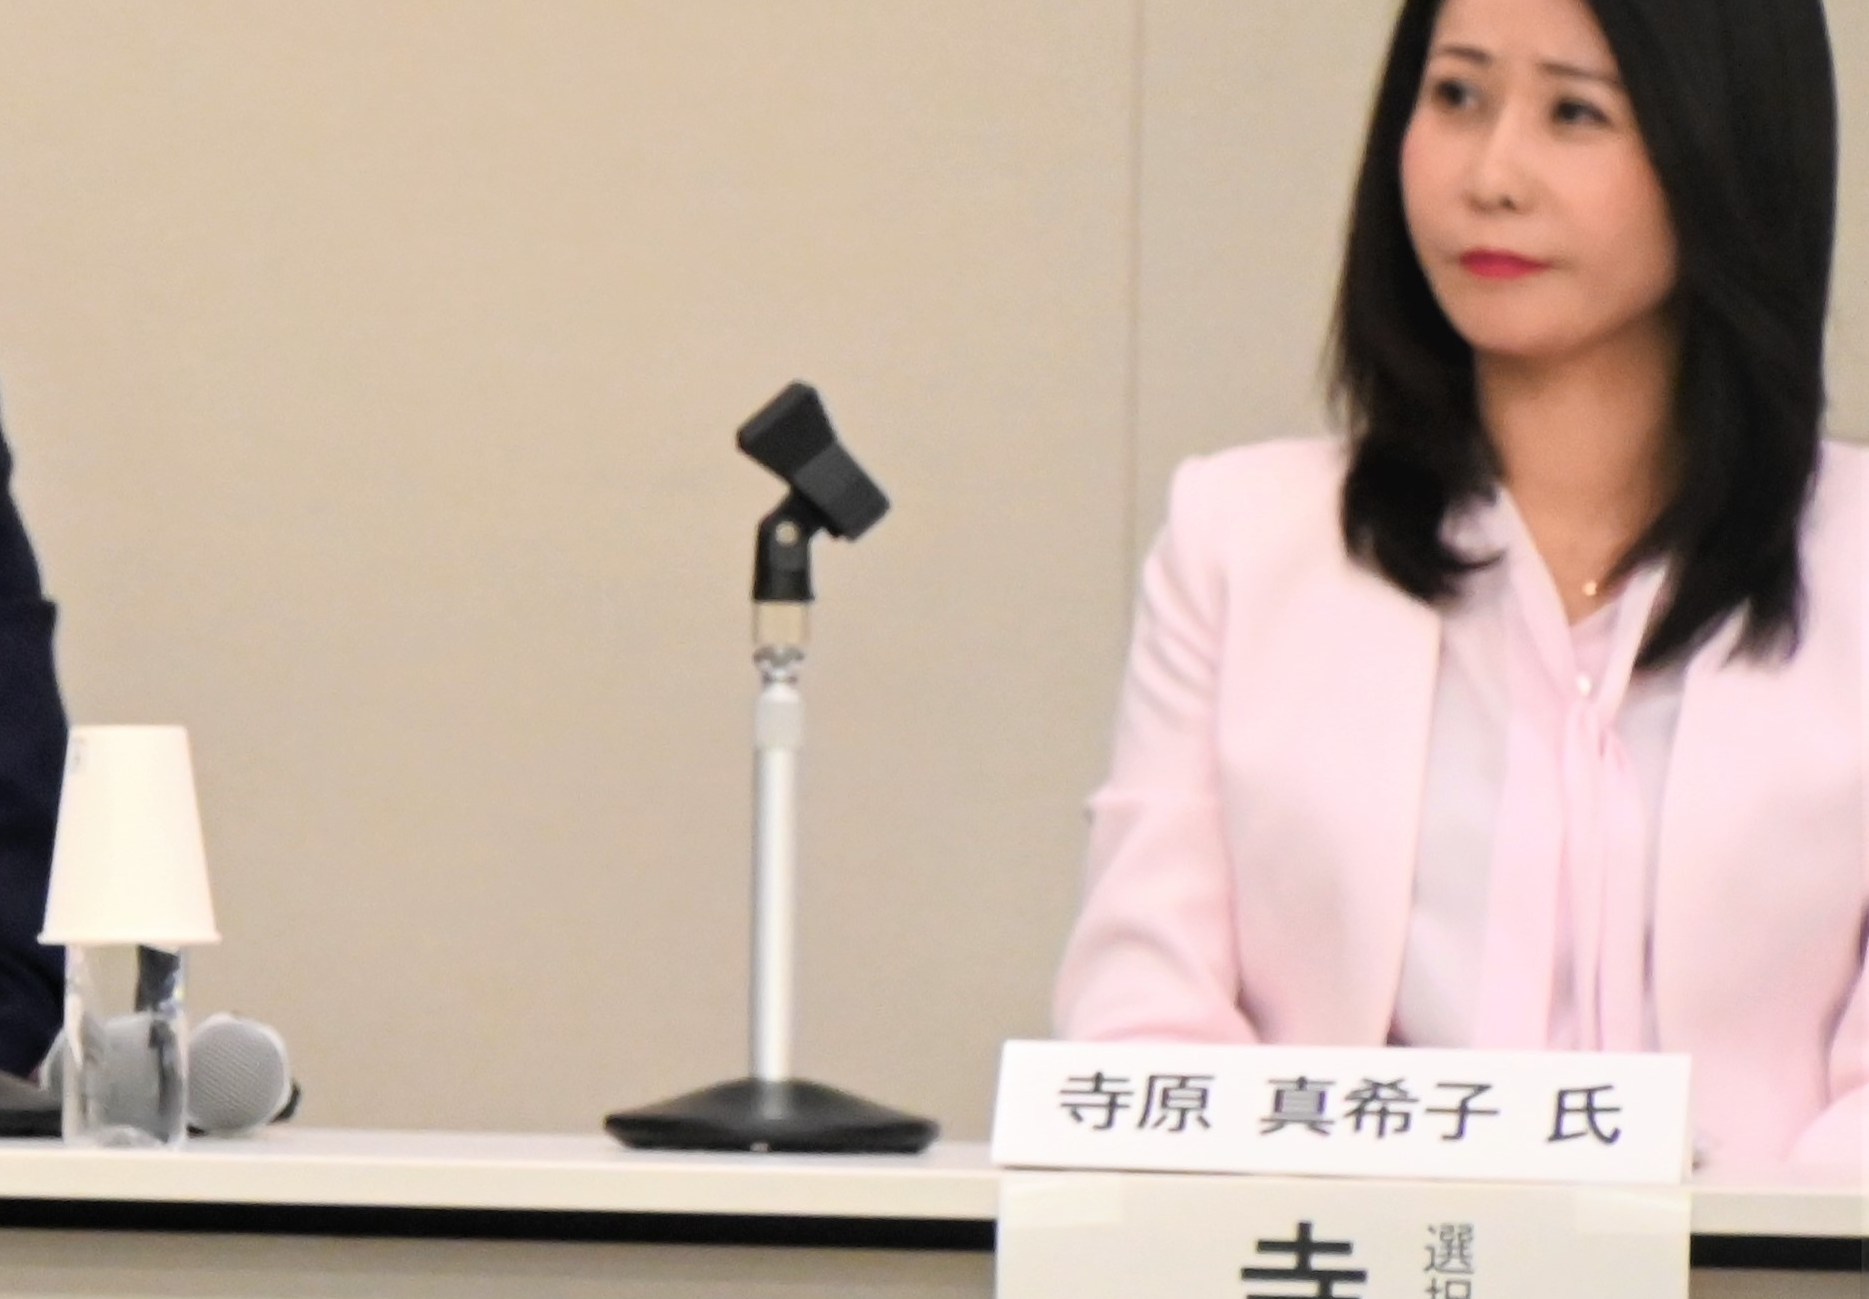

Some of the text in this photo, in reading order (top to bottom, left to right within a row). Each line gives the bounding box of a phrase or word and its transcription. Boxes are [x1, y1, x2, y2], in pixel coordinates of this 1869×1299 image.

[1059, 1071, 1622, 1145] 寺原 真希子 氏
